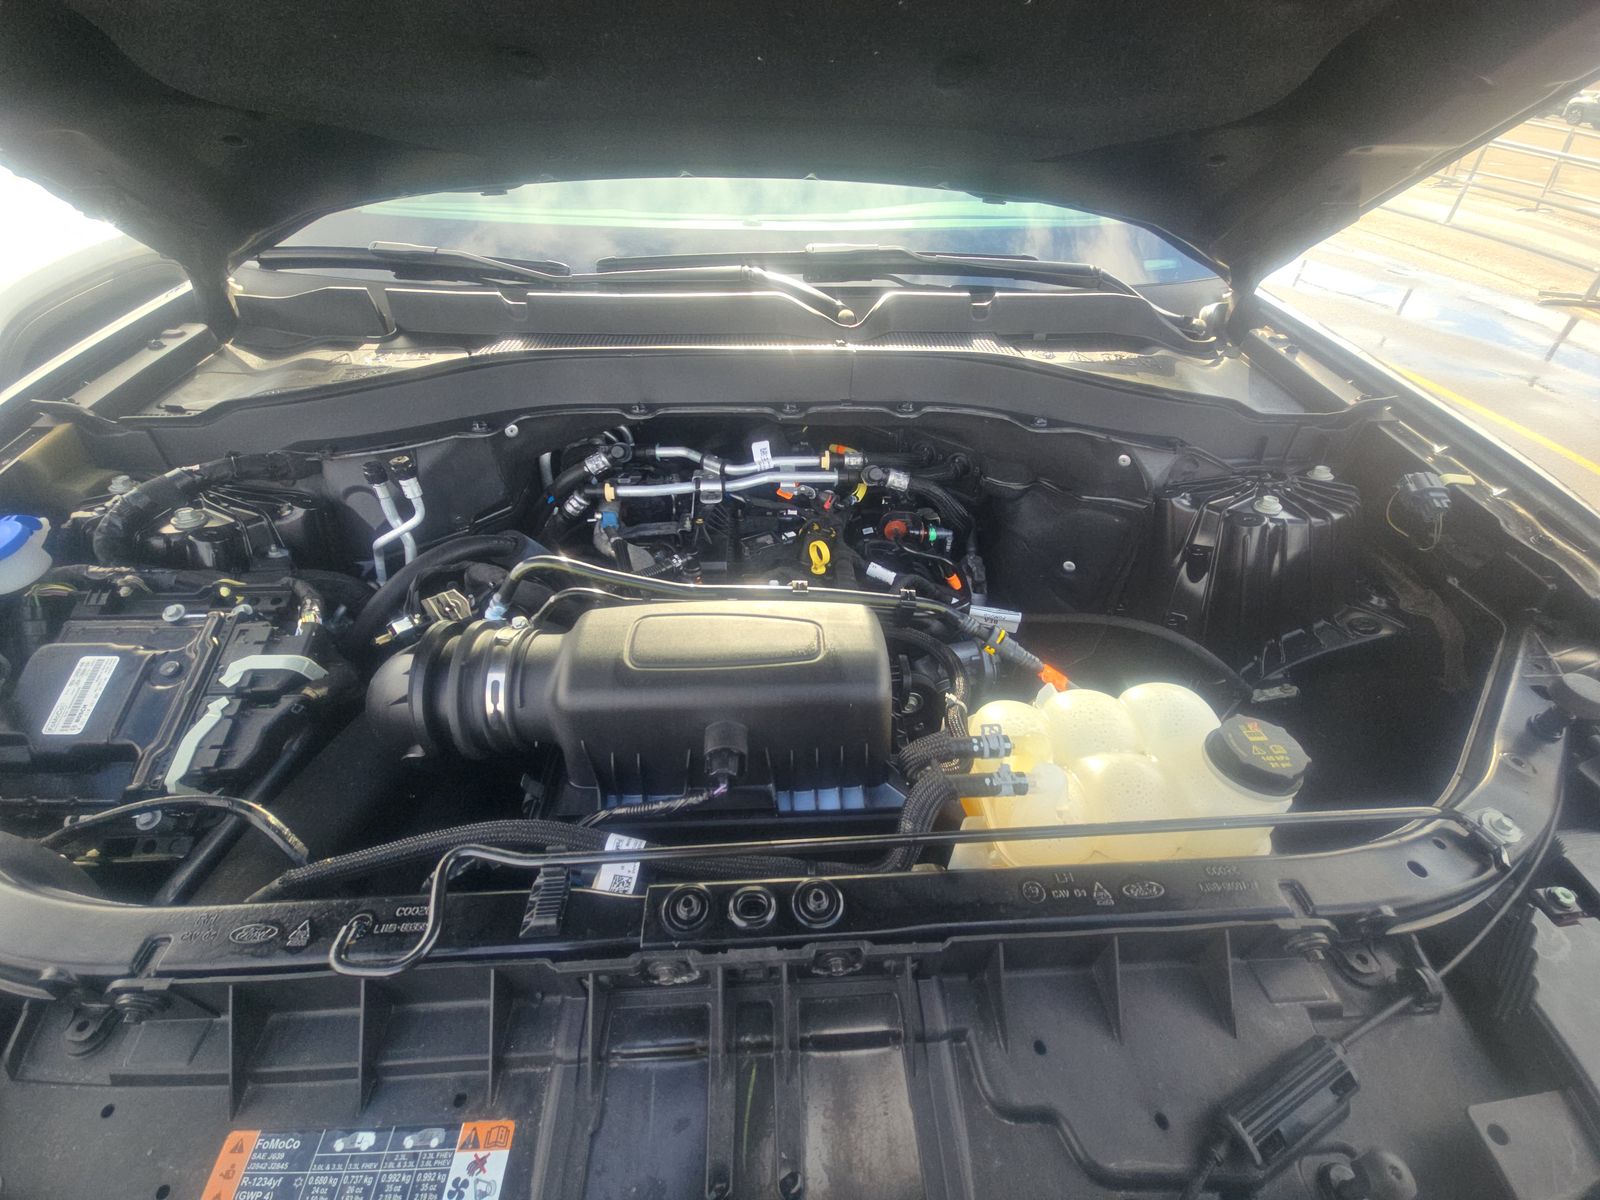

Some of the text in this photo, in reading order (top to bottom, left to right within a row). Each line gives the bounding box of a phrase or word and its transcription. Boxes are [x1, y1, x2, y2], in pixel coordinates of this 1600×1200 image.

[255, 1138, 300, 1149] FoMoCo
[251, 1152, 267, 1160] SAE
[241, 1177, 283, 1189] R-1234yf
[328, 1176, 339, 1187] kg
[343, 1175, 374, 1186] 0.737 kg
[401, 1173, 412, 1184] kg
[437, 1172, 447, 1183] kg
